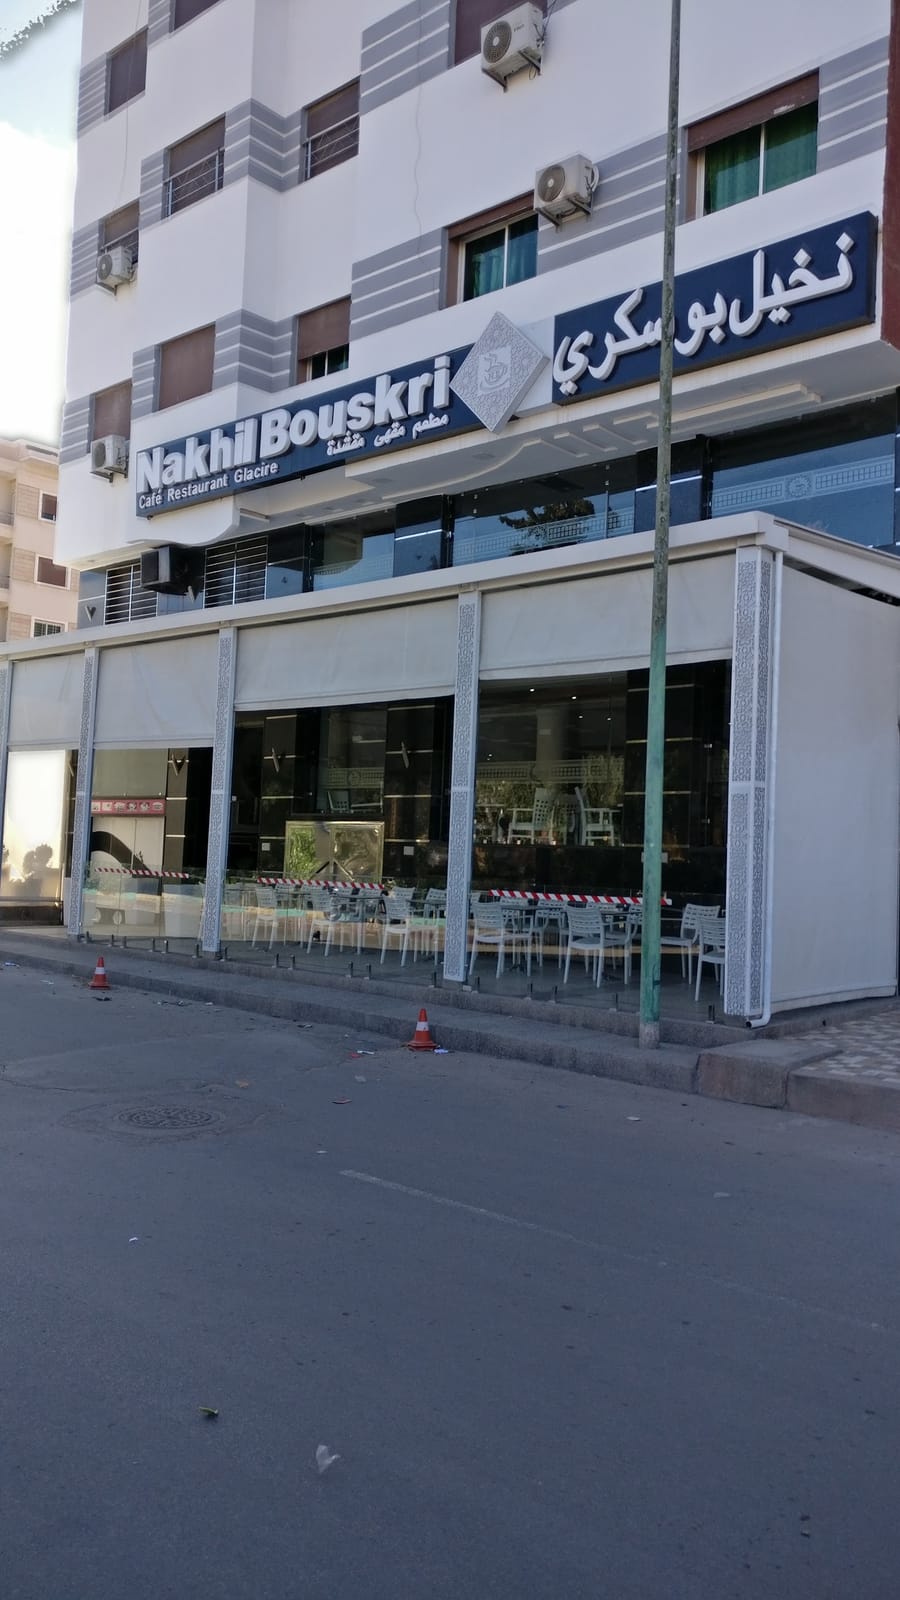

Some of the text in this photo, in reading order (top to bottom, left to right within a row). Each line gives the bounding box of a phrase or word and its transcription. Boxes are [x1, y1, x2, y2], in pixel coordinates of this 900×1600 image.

[729, 232, 854, 337] نخيل
[136, 355, 451, 493] Nakhil Bouskri
[412, 412, 450, 440] مطعم
[139, 461, 279, 509] Café Restaurant Glacire
